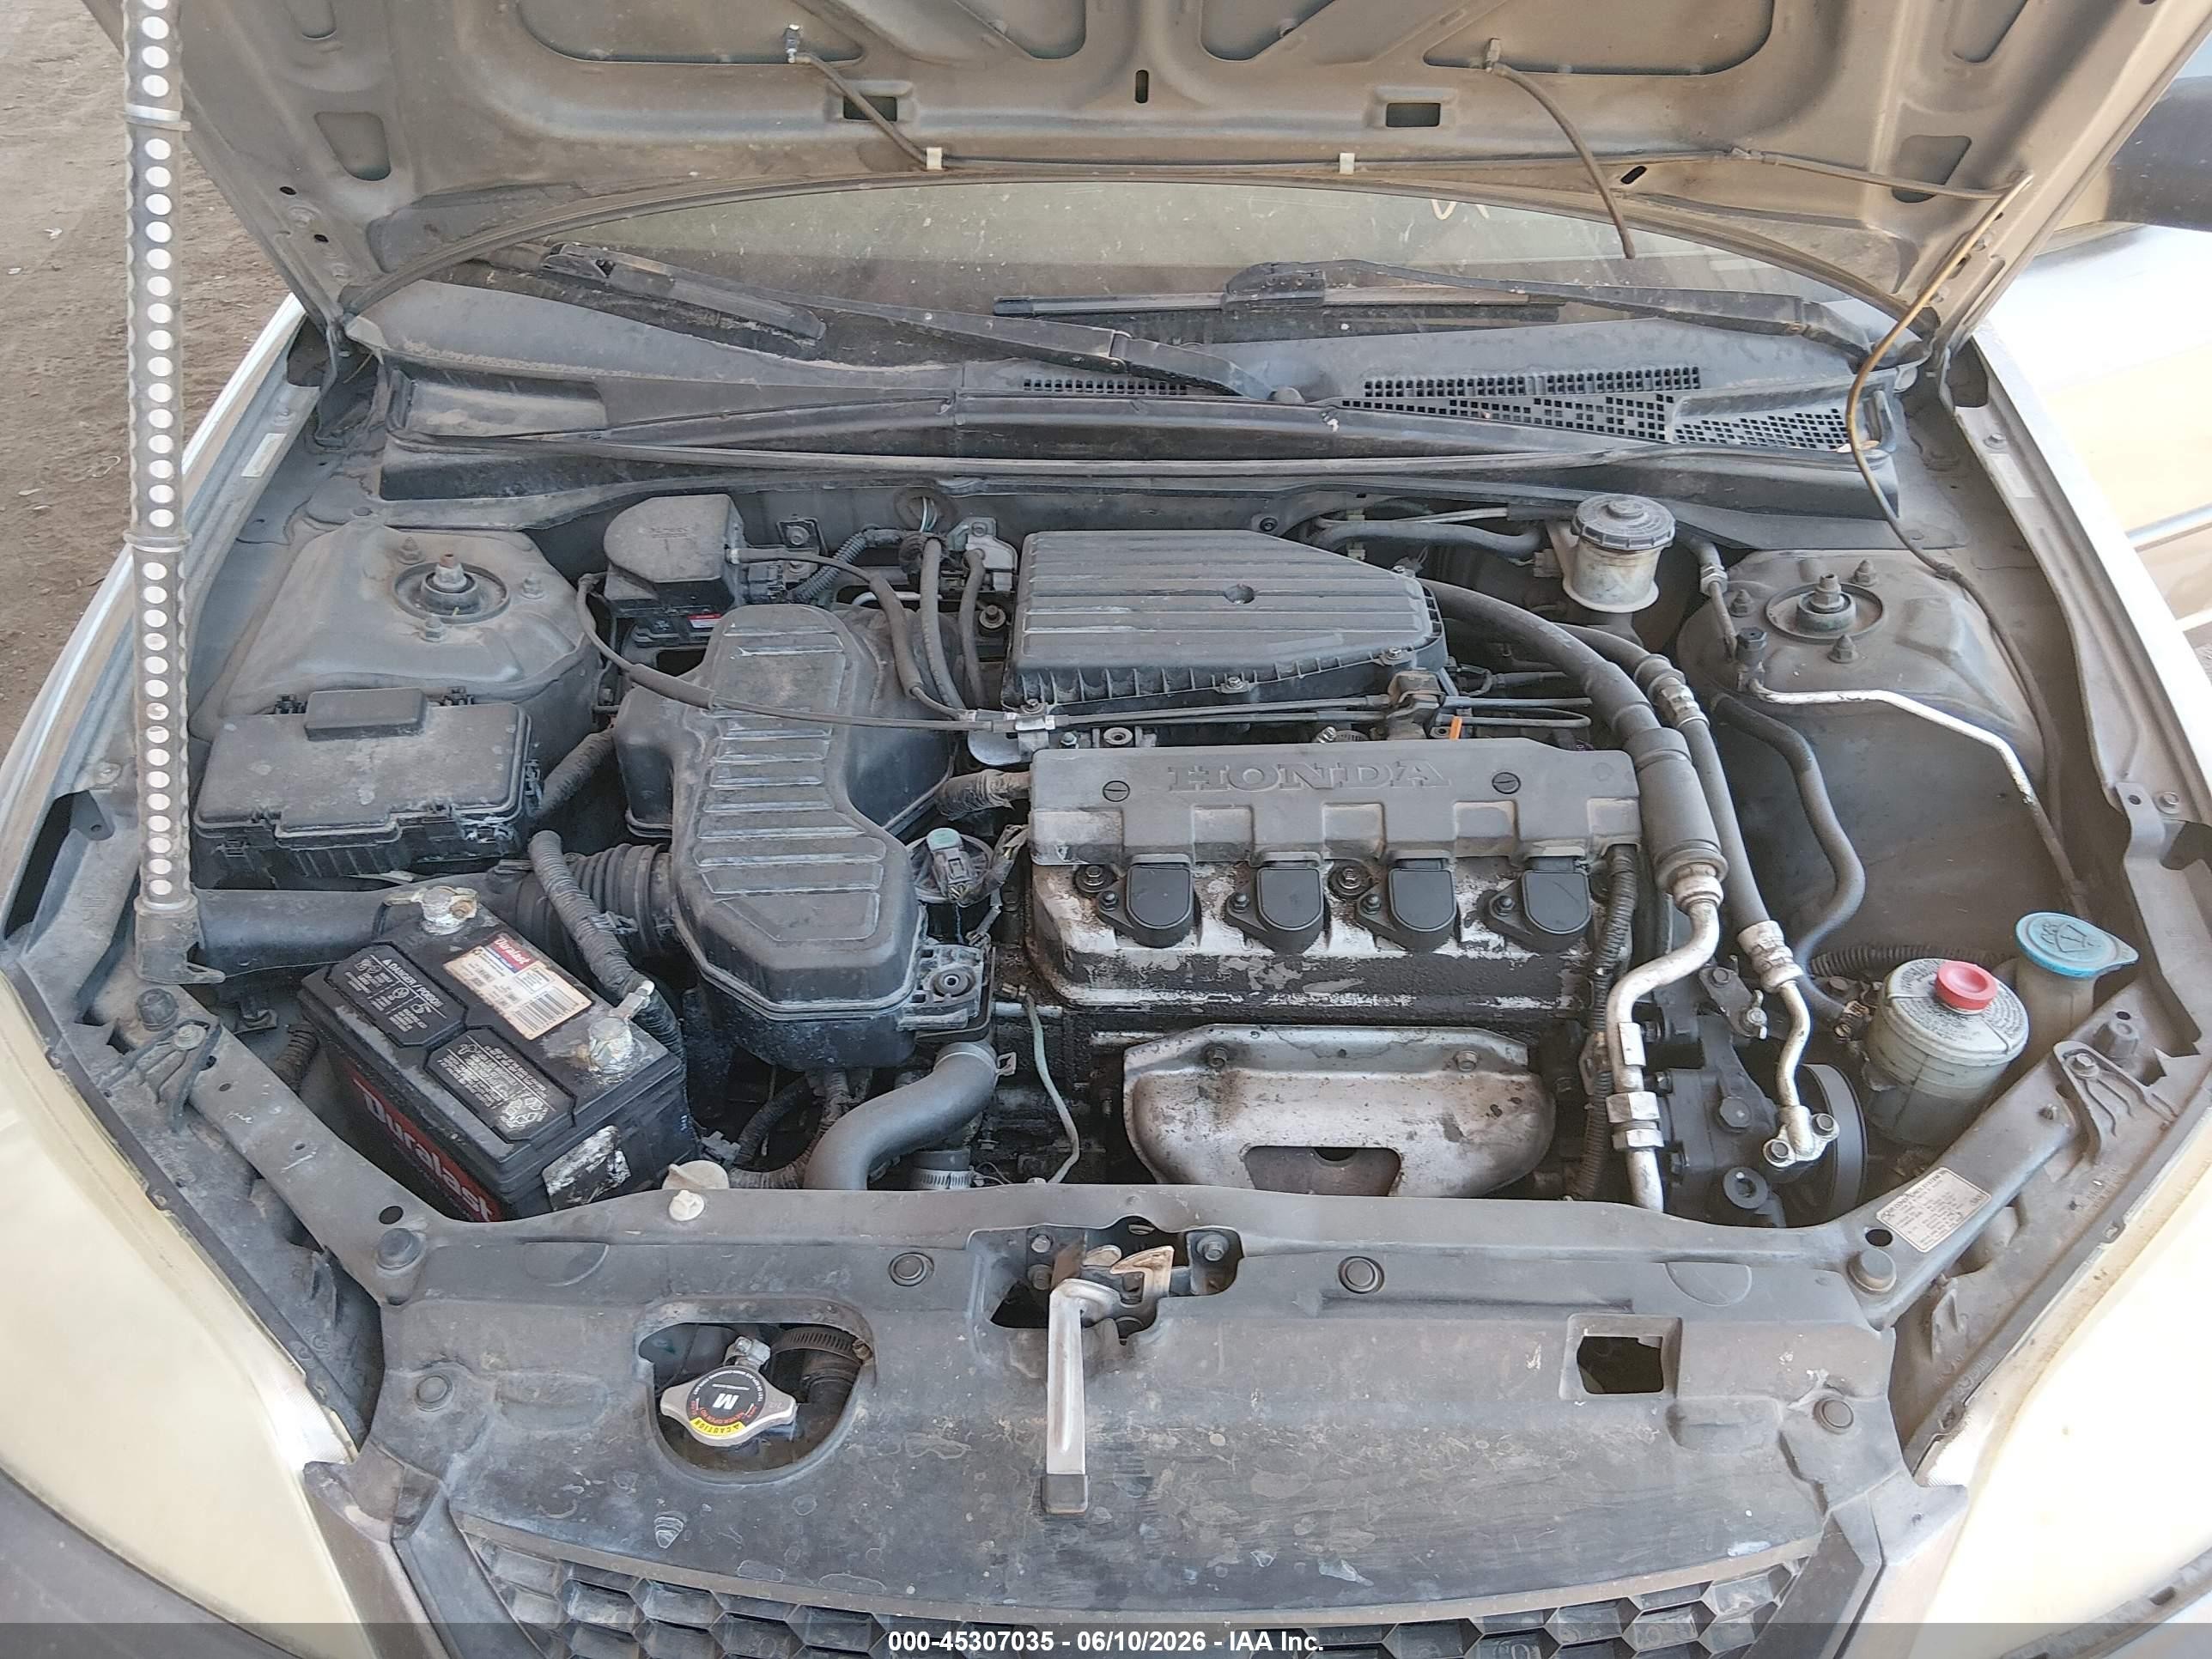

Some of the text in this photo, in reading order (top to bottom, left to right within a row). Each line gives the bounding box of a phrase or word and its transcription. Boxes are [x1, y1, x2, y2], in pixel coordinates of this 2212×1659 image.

[1167, 758, 1452, 793] HONDA
[494, 938, 532, 965] Duralast
[388, 963, 417, 986] DANGER
[416, 987, 444, 1008] POISON
[353, 1079, 493, 1222] Duralast
[712, 1393, 739, 1410] M
[694, 1419, 732, 1434] CAUTION
